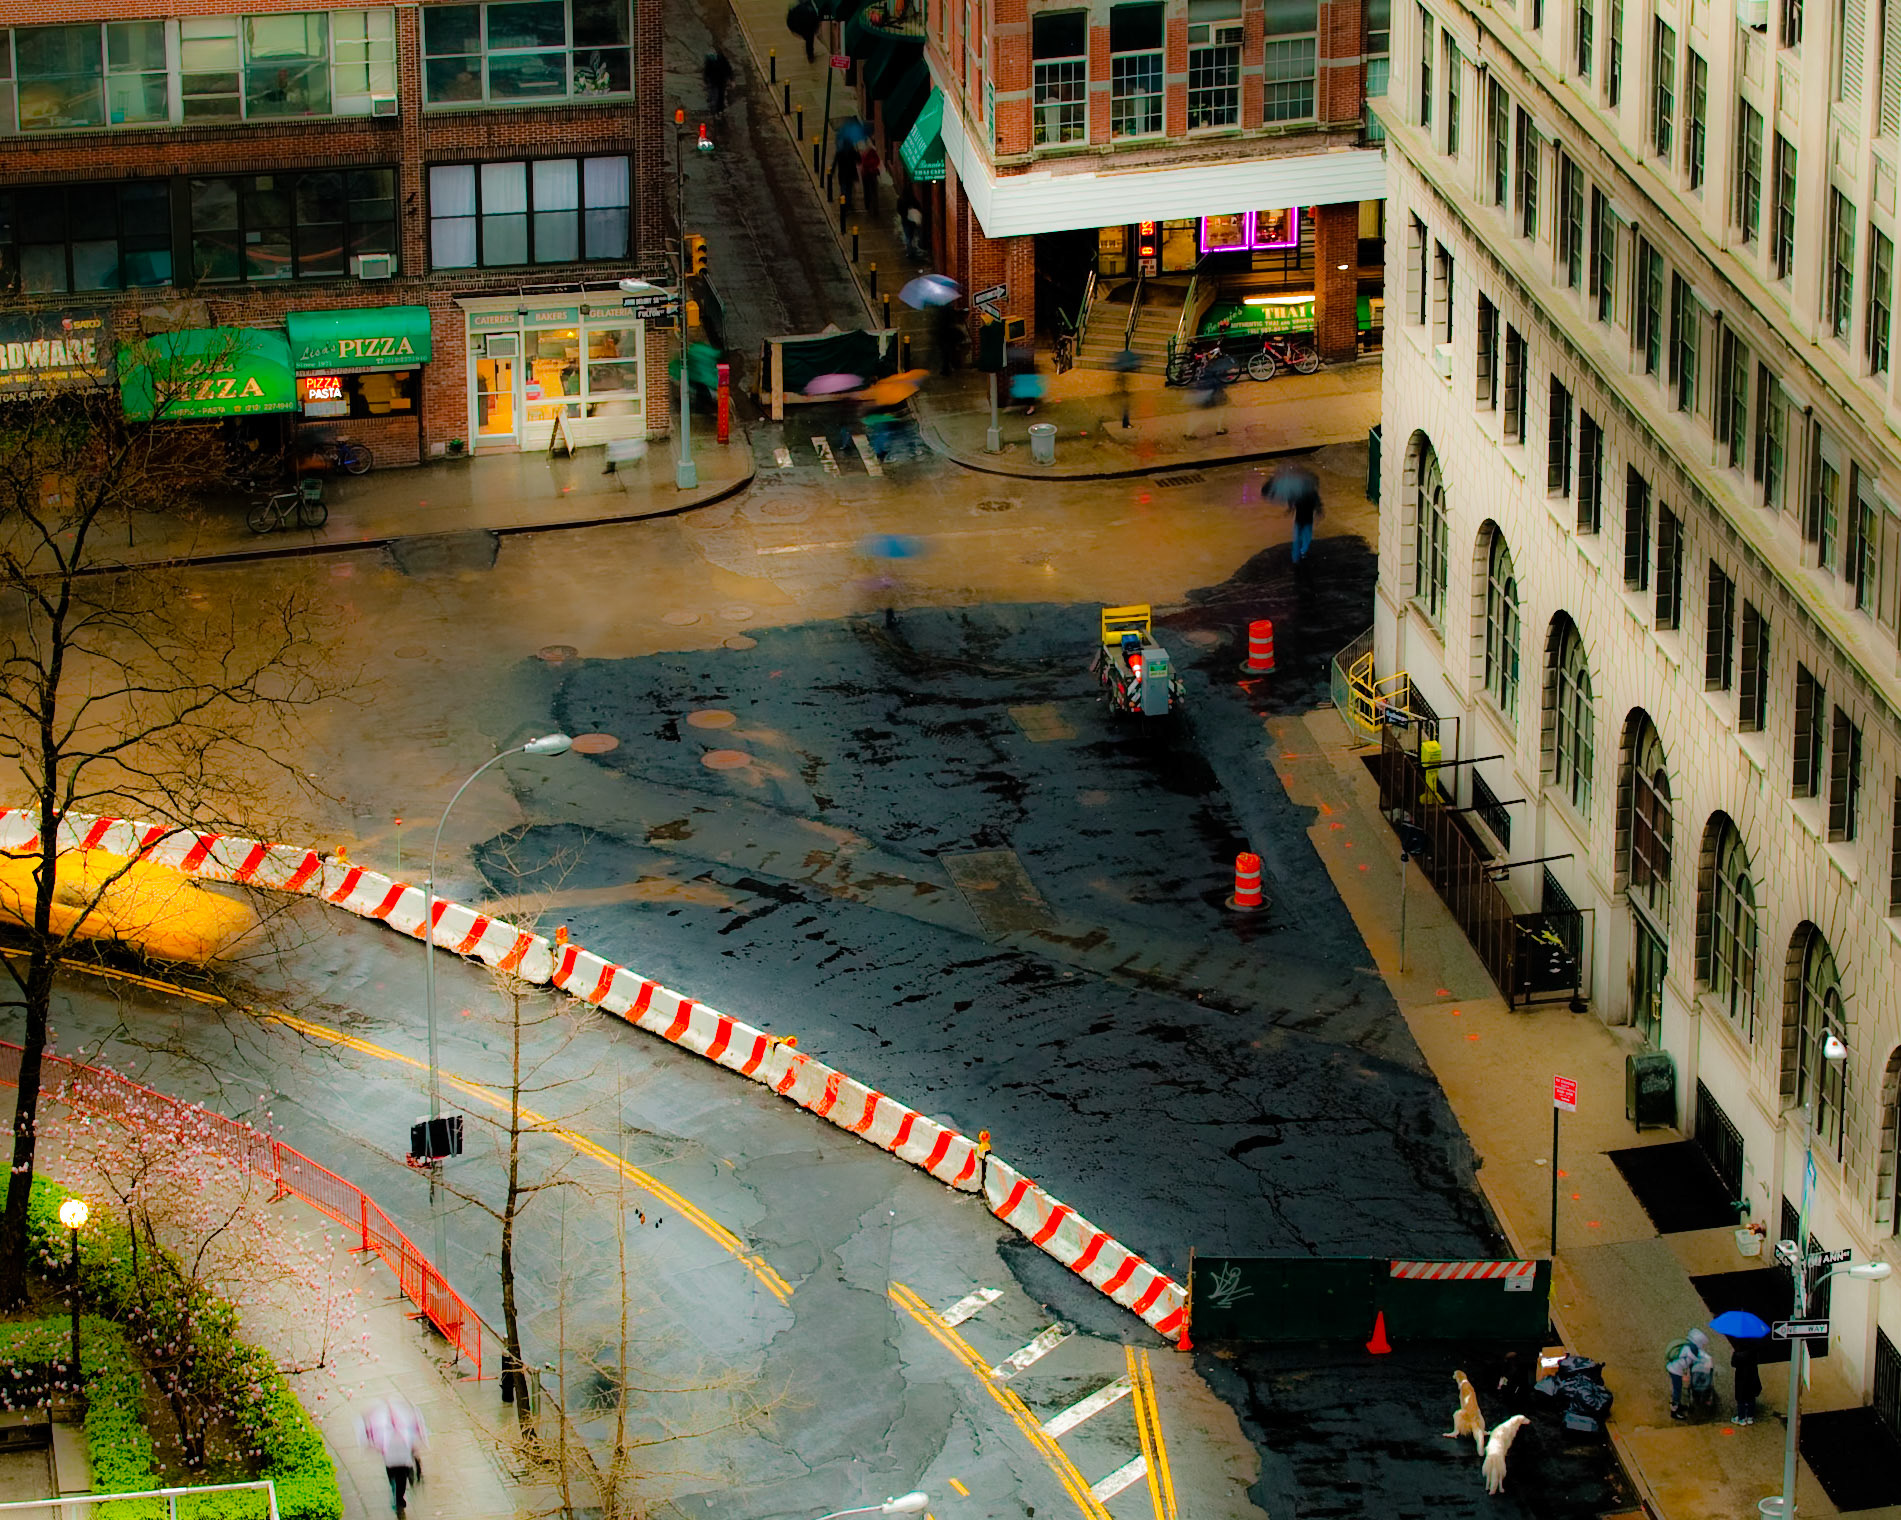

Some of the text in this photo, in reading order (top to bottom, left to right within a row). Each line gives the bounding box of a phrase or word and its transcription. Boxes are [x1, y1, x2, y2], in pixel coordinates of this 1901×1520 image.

[535, 311, 567, 322] BAKERS
[589, 307, 633, 319] GELATERIA
[1262, 305, 1306, 319] THAI
[475, 314, 515, 326] CATERERS
[300, 337, 414, 360] Lisa's PIZZA
[306, 377, 341, 389] PIZZA
[309, 387, 342, 399] PASTA
[1823, 1251, 1843, 1263] ANN
[1781, 1326, 1798, 1334] ONE
